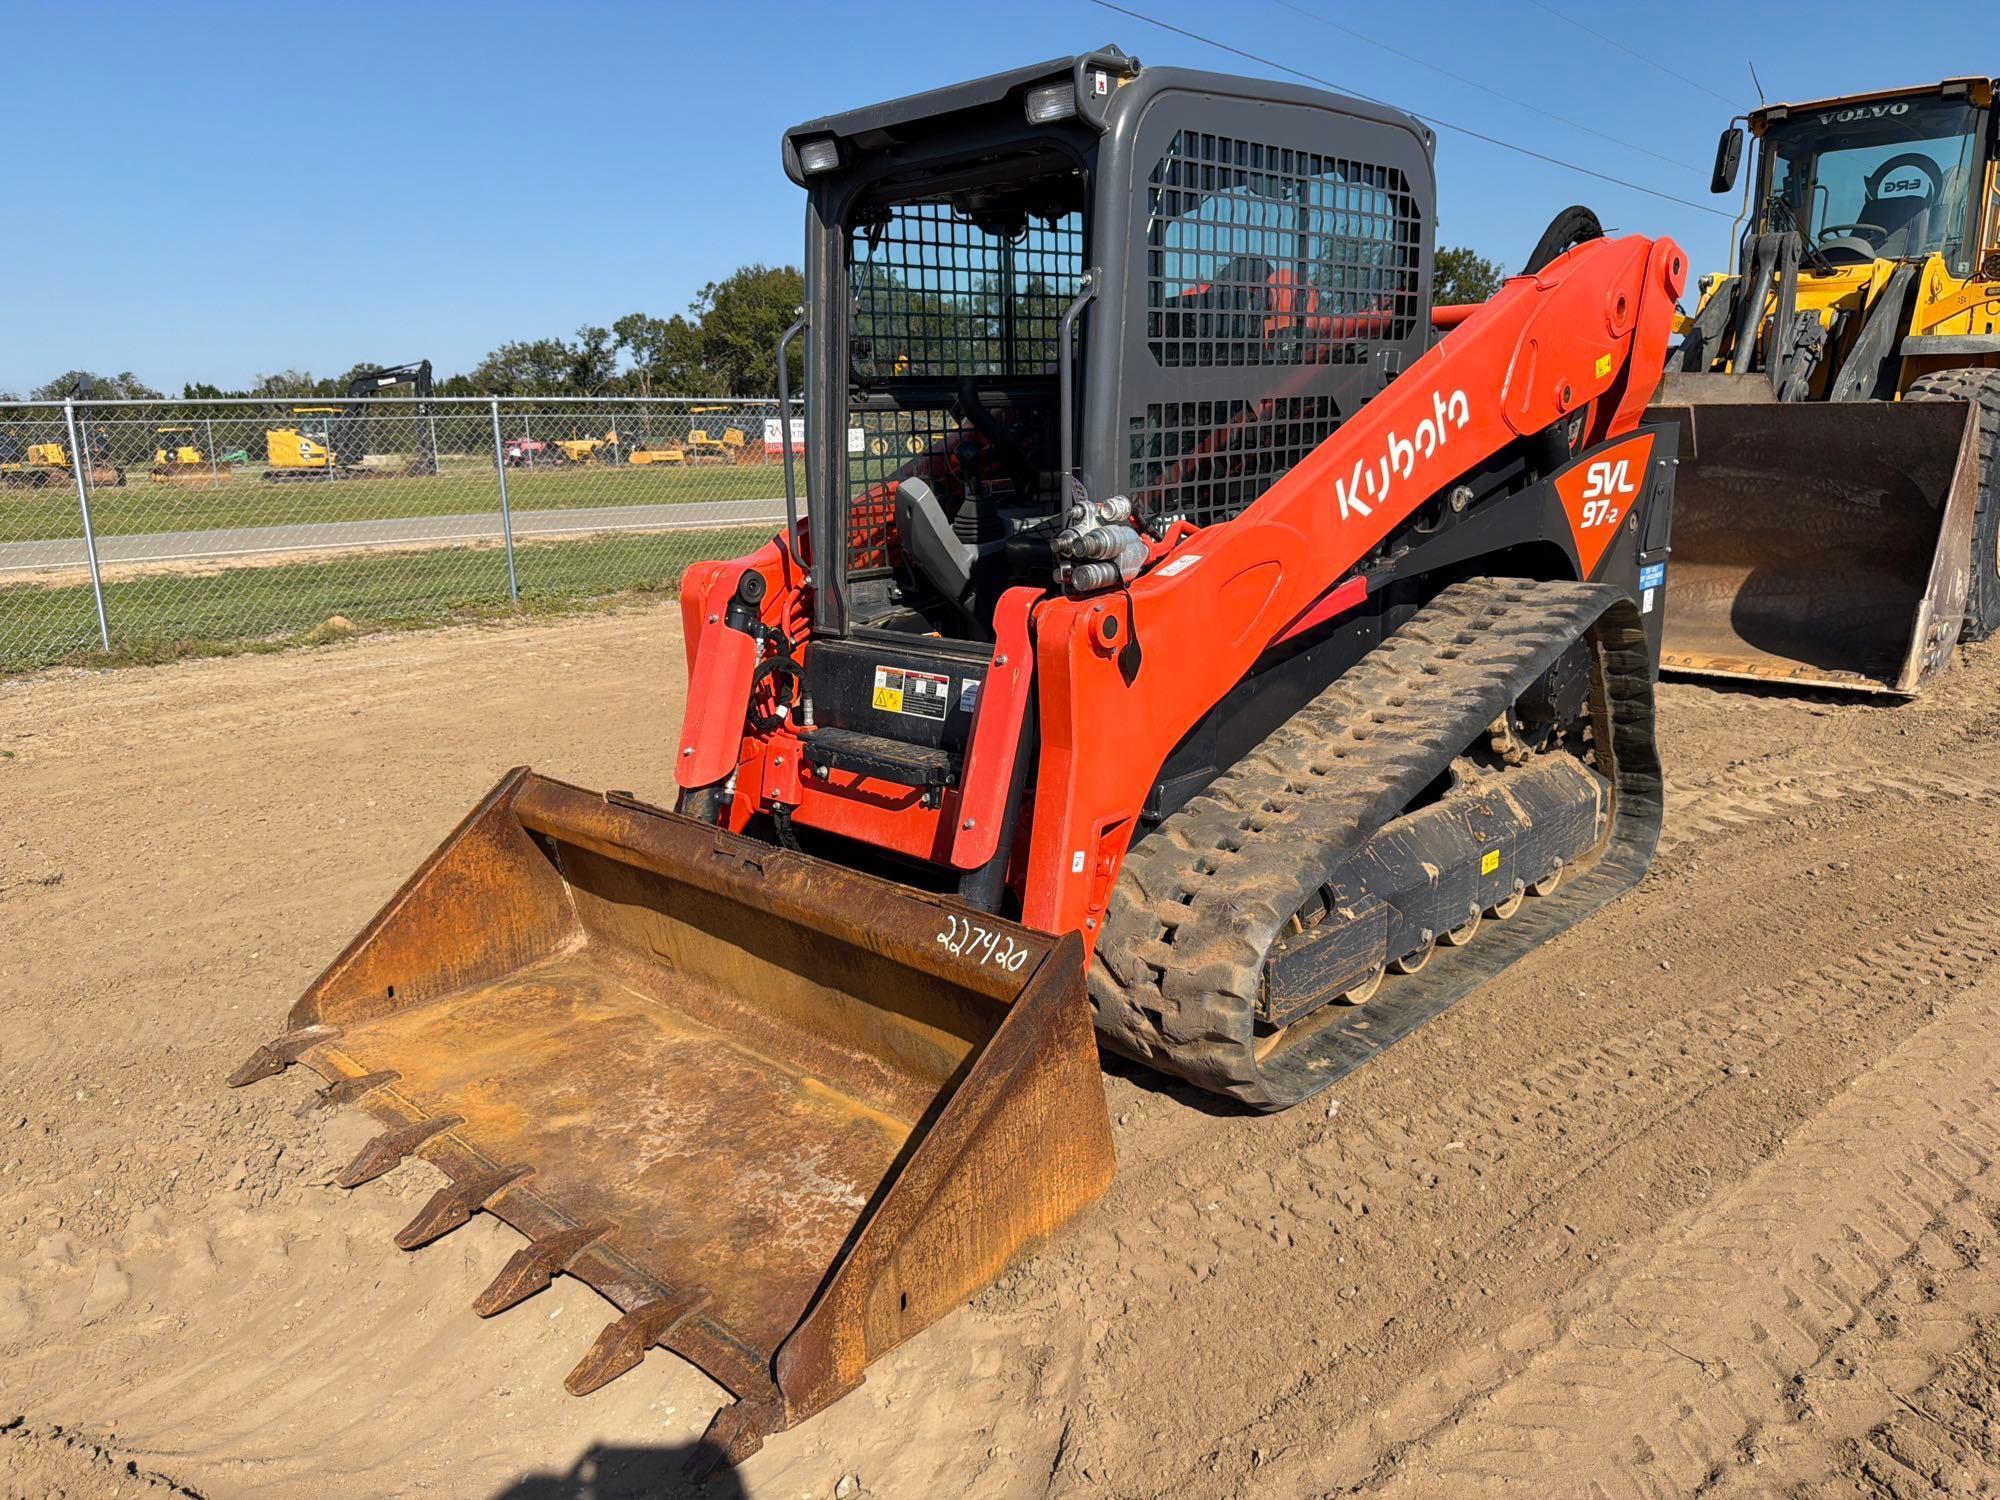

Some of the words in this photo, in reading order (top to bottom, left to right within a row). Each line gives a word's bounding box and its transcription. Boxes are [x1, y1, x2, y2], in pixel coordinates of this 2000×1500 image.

[1817, 103, 1909, 125] VOLVO
[1335, 389, 1470, 521] Kubota
[1582, 460, 1635, 499] SVL
[1580, 499, 1619, 529] 97-2
[937, 915, 1028, 972] 227420
